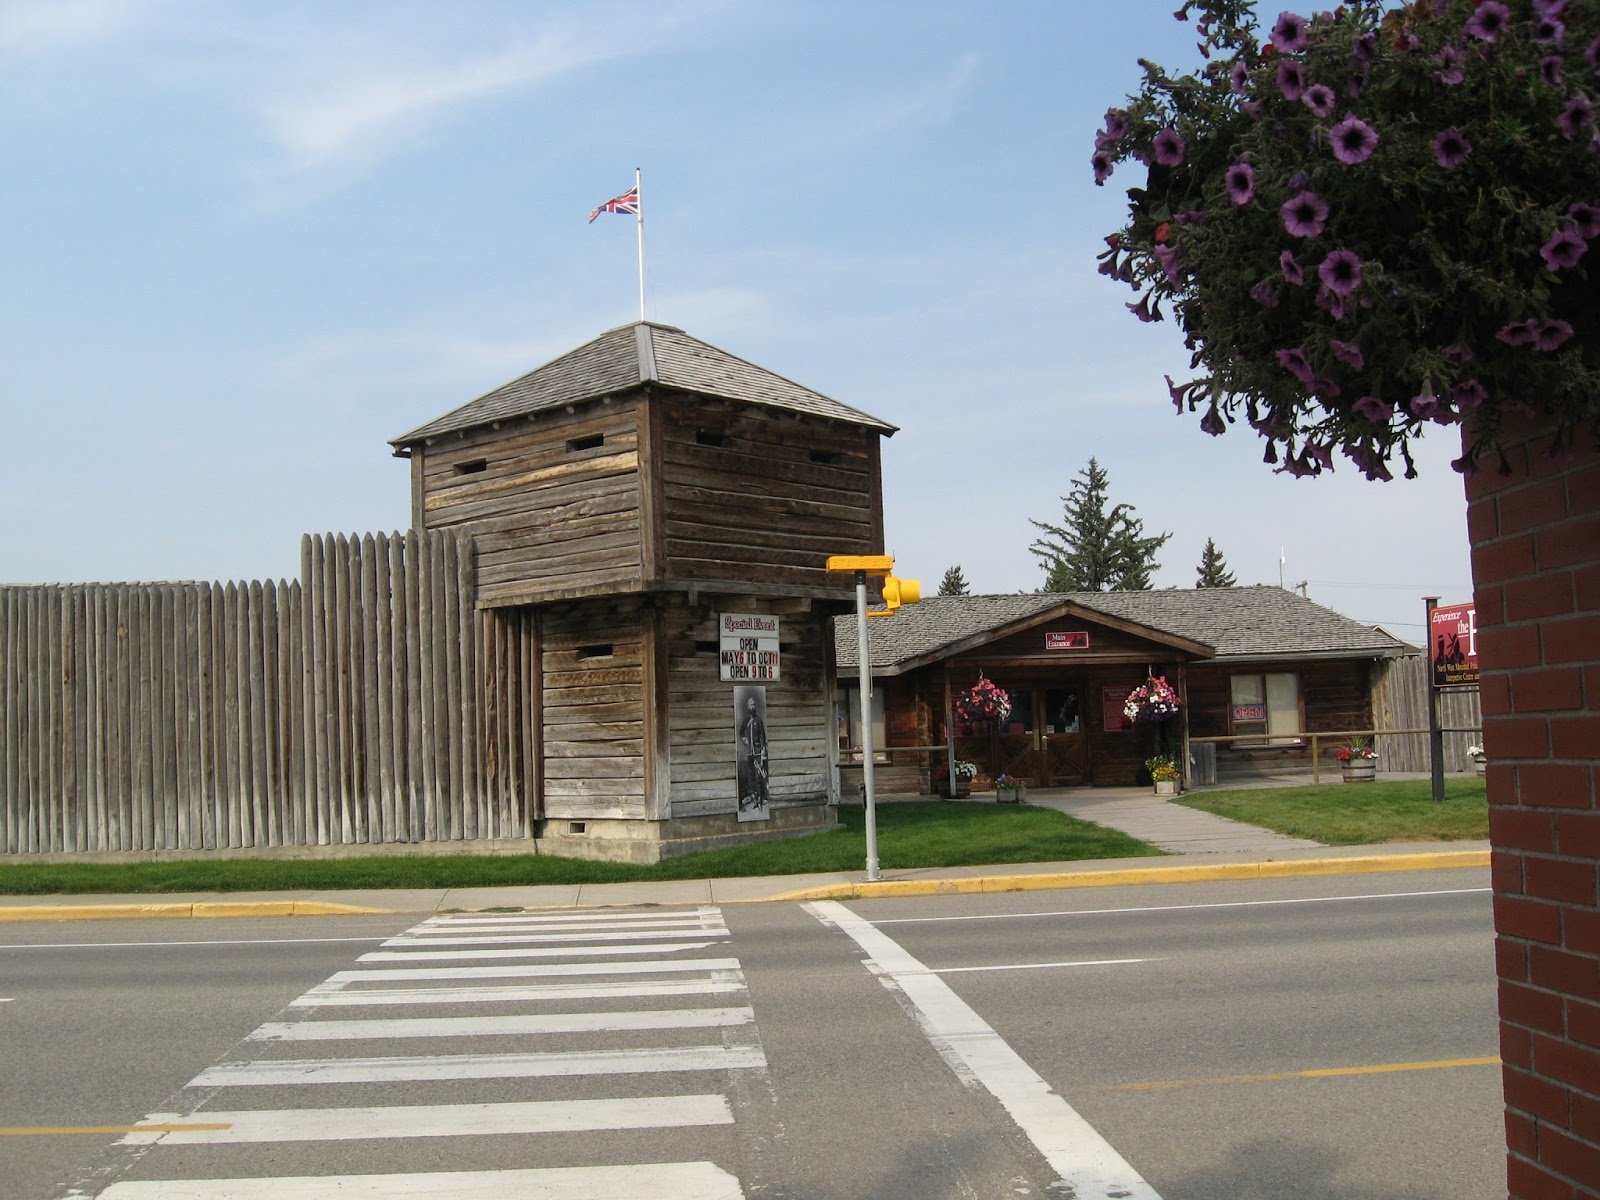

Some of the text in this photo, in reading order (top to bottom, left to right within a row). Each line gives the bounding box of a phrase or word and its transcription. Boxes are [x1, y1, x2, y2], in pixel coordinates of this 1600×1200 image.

[1433, 611, 1461, 623] Experience
[725, 616, 775, 632] Special Event
[1458, 620, 1469, 634] the
[740, 638, 758, 650] OPEN
[747, 652, 756, 665] TO
[730, 666, 773, 679] OPEN 9 TO 6
[1234, 707, 1263, 718] OPEN
